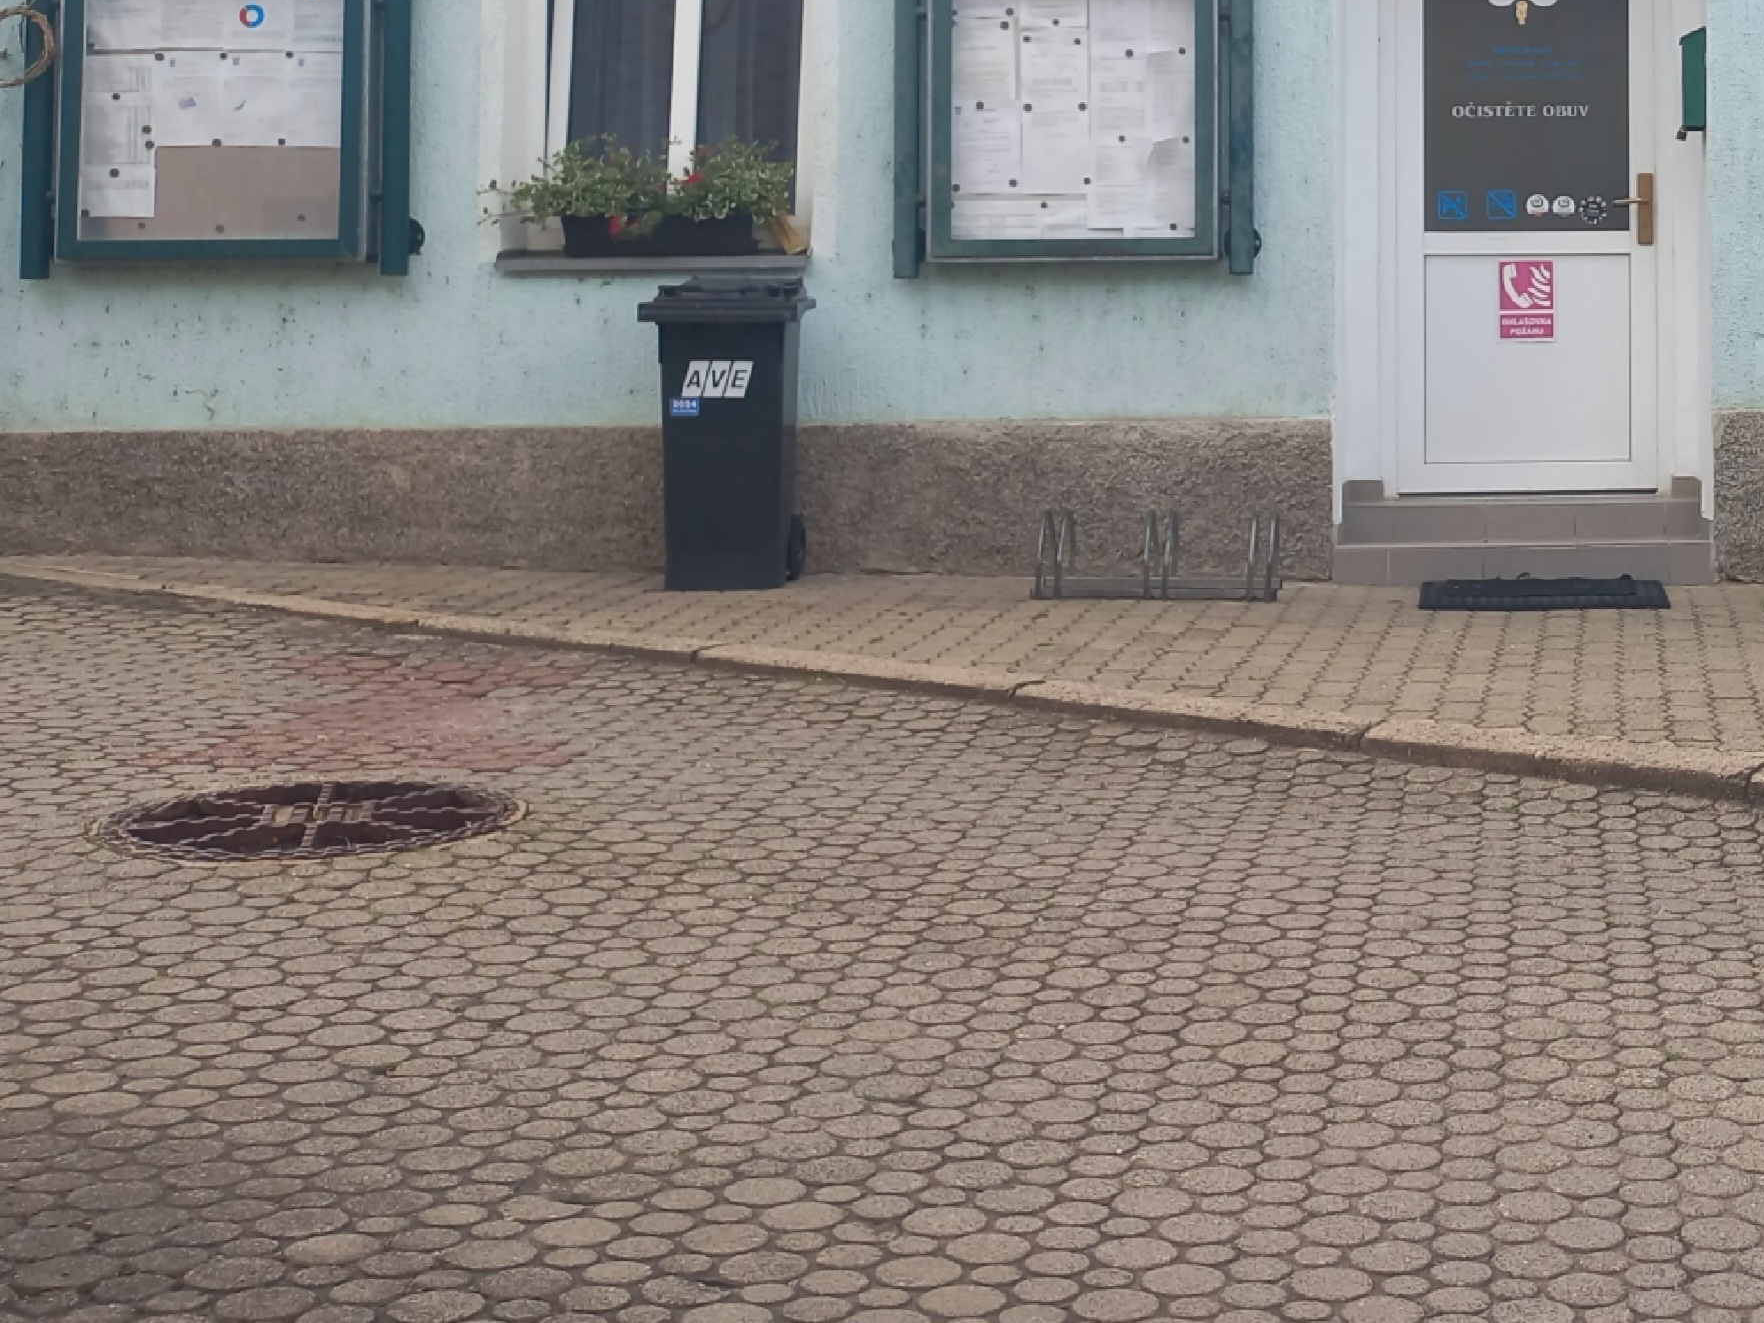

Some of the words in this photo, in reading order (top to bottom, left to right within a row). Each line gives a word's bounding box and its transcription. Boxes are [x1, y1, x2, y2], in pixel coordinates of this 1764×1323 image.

[1451, 100, 1537, 118] OČISTĚTE
[1542, 104, 1590, 118] OBUV
[685, 367, 749, 390] AVE
